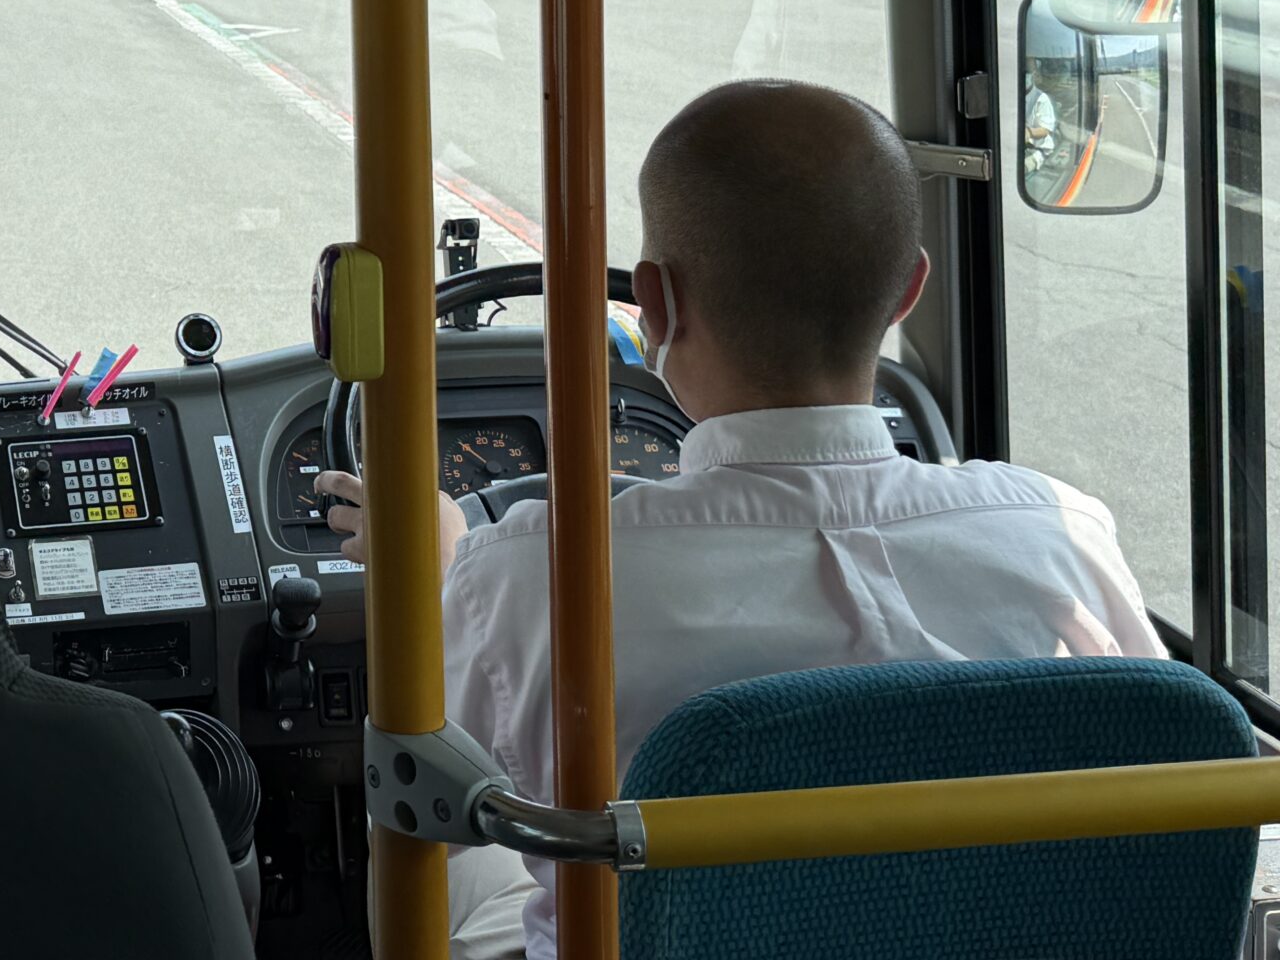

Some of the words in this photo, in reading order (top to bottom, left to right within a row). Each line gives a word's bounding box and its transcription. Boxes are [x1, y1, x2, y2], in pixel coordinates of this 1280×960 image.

[476, 436, 488, 445] 20
[615, 434, 629, 444] 60
[493, 440, 505, 448] 25
[644, 443, 659, 453] 80
[13, 451, 40, 459] LECIP
[509, 448, 521, 457] 30
[453, 454, 463, 463] 10
[519, 463, 531, 471] 35
[661, 463, 679, 472] 100
[453, 470, 460, 478] 5
[218, 445, 249, 524] 横断歩道確認
[462, 483, 469, 491] 0
[270, 566, 298, 574] RELEASE
